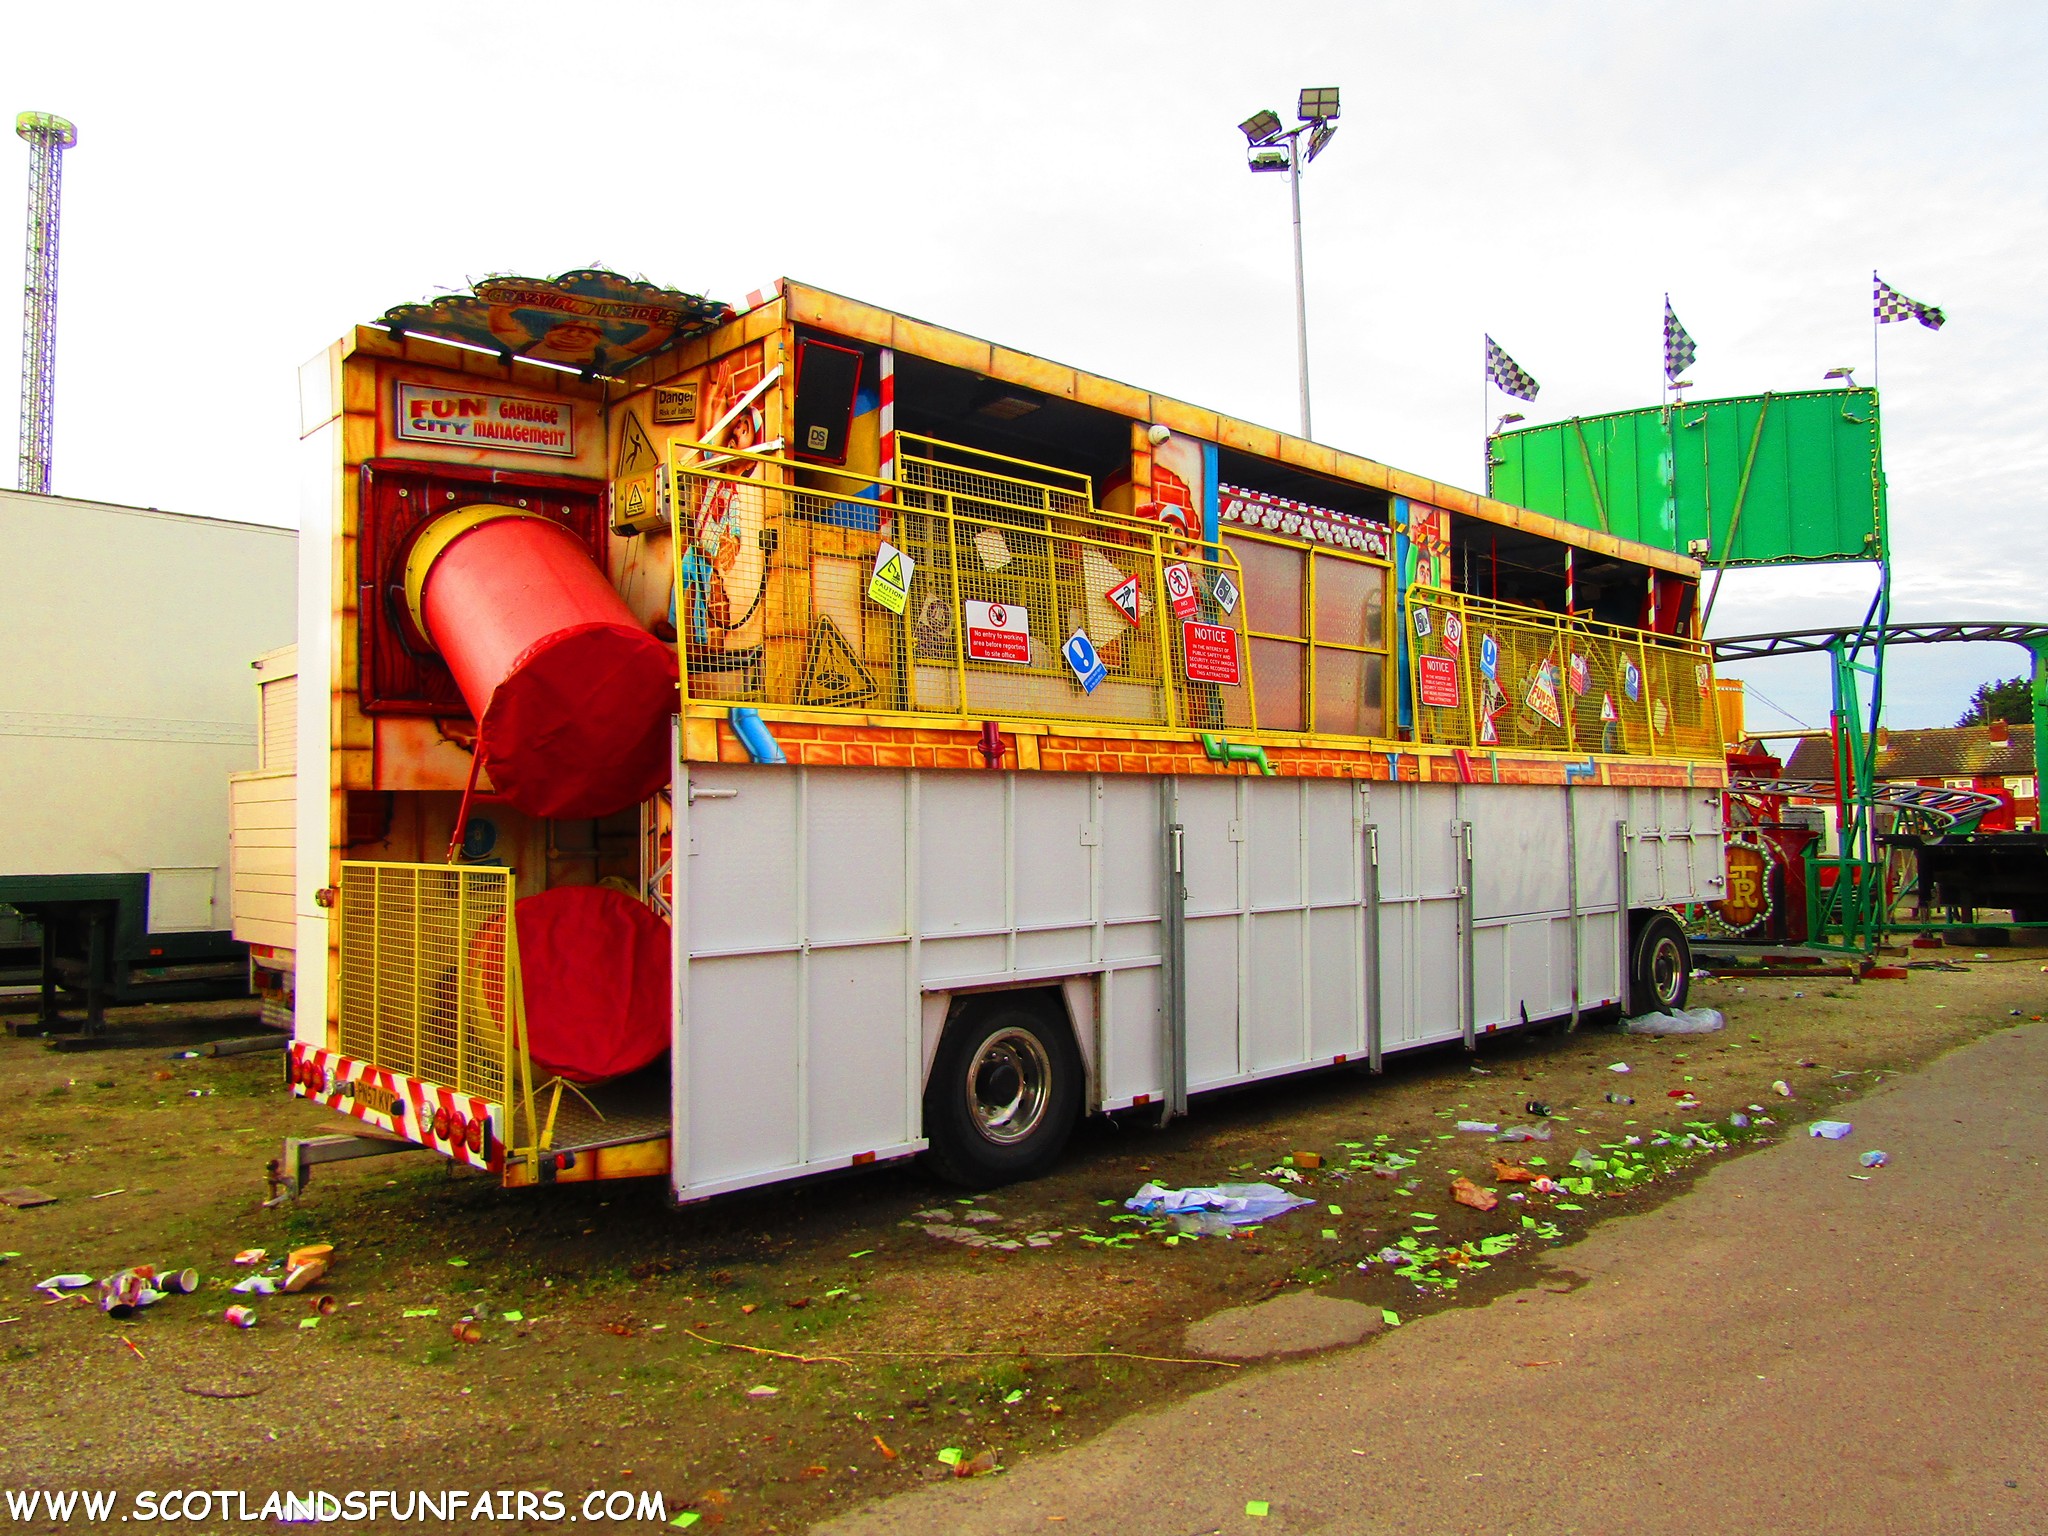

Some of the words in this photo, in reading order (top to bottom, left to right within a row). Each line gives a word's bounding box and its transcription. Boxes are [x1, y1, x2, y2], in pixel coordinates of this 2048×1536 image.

[488, 290, 554, 306] CRAZY
[552, 297, 595, 314] FUN
[600, 304, 662, 320] INSIDE
[410, 398, 487, 418] FUN
[677, 407, 693, 416] falling
[412, 419, 470, 436] CITY
[811, 429, 825, 441] DS
[875, 580, 903, 600] CAUTION
[1177, 607, 1196, 616] running
[982, 632, 996, 640] entry
[1003, 634, 1024, 642] working
[1194, 627, 1227, 643] NOTICE
[1002, 643, 1026, 652] reporting
[1001, 651, 1016, 659] office
[1426, 660, 1450, 673] NOTICE
[1206, 671, 1230, 679] ATTRACTION
[1532, 685, 1547, 702] FUN
